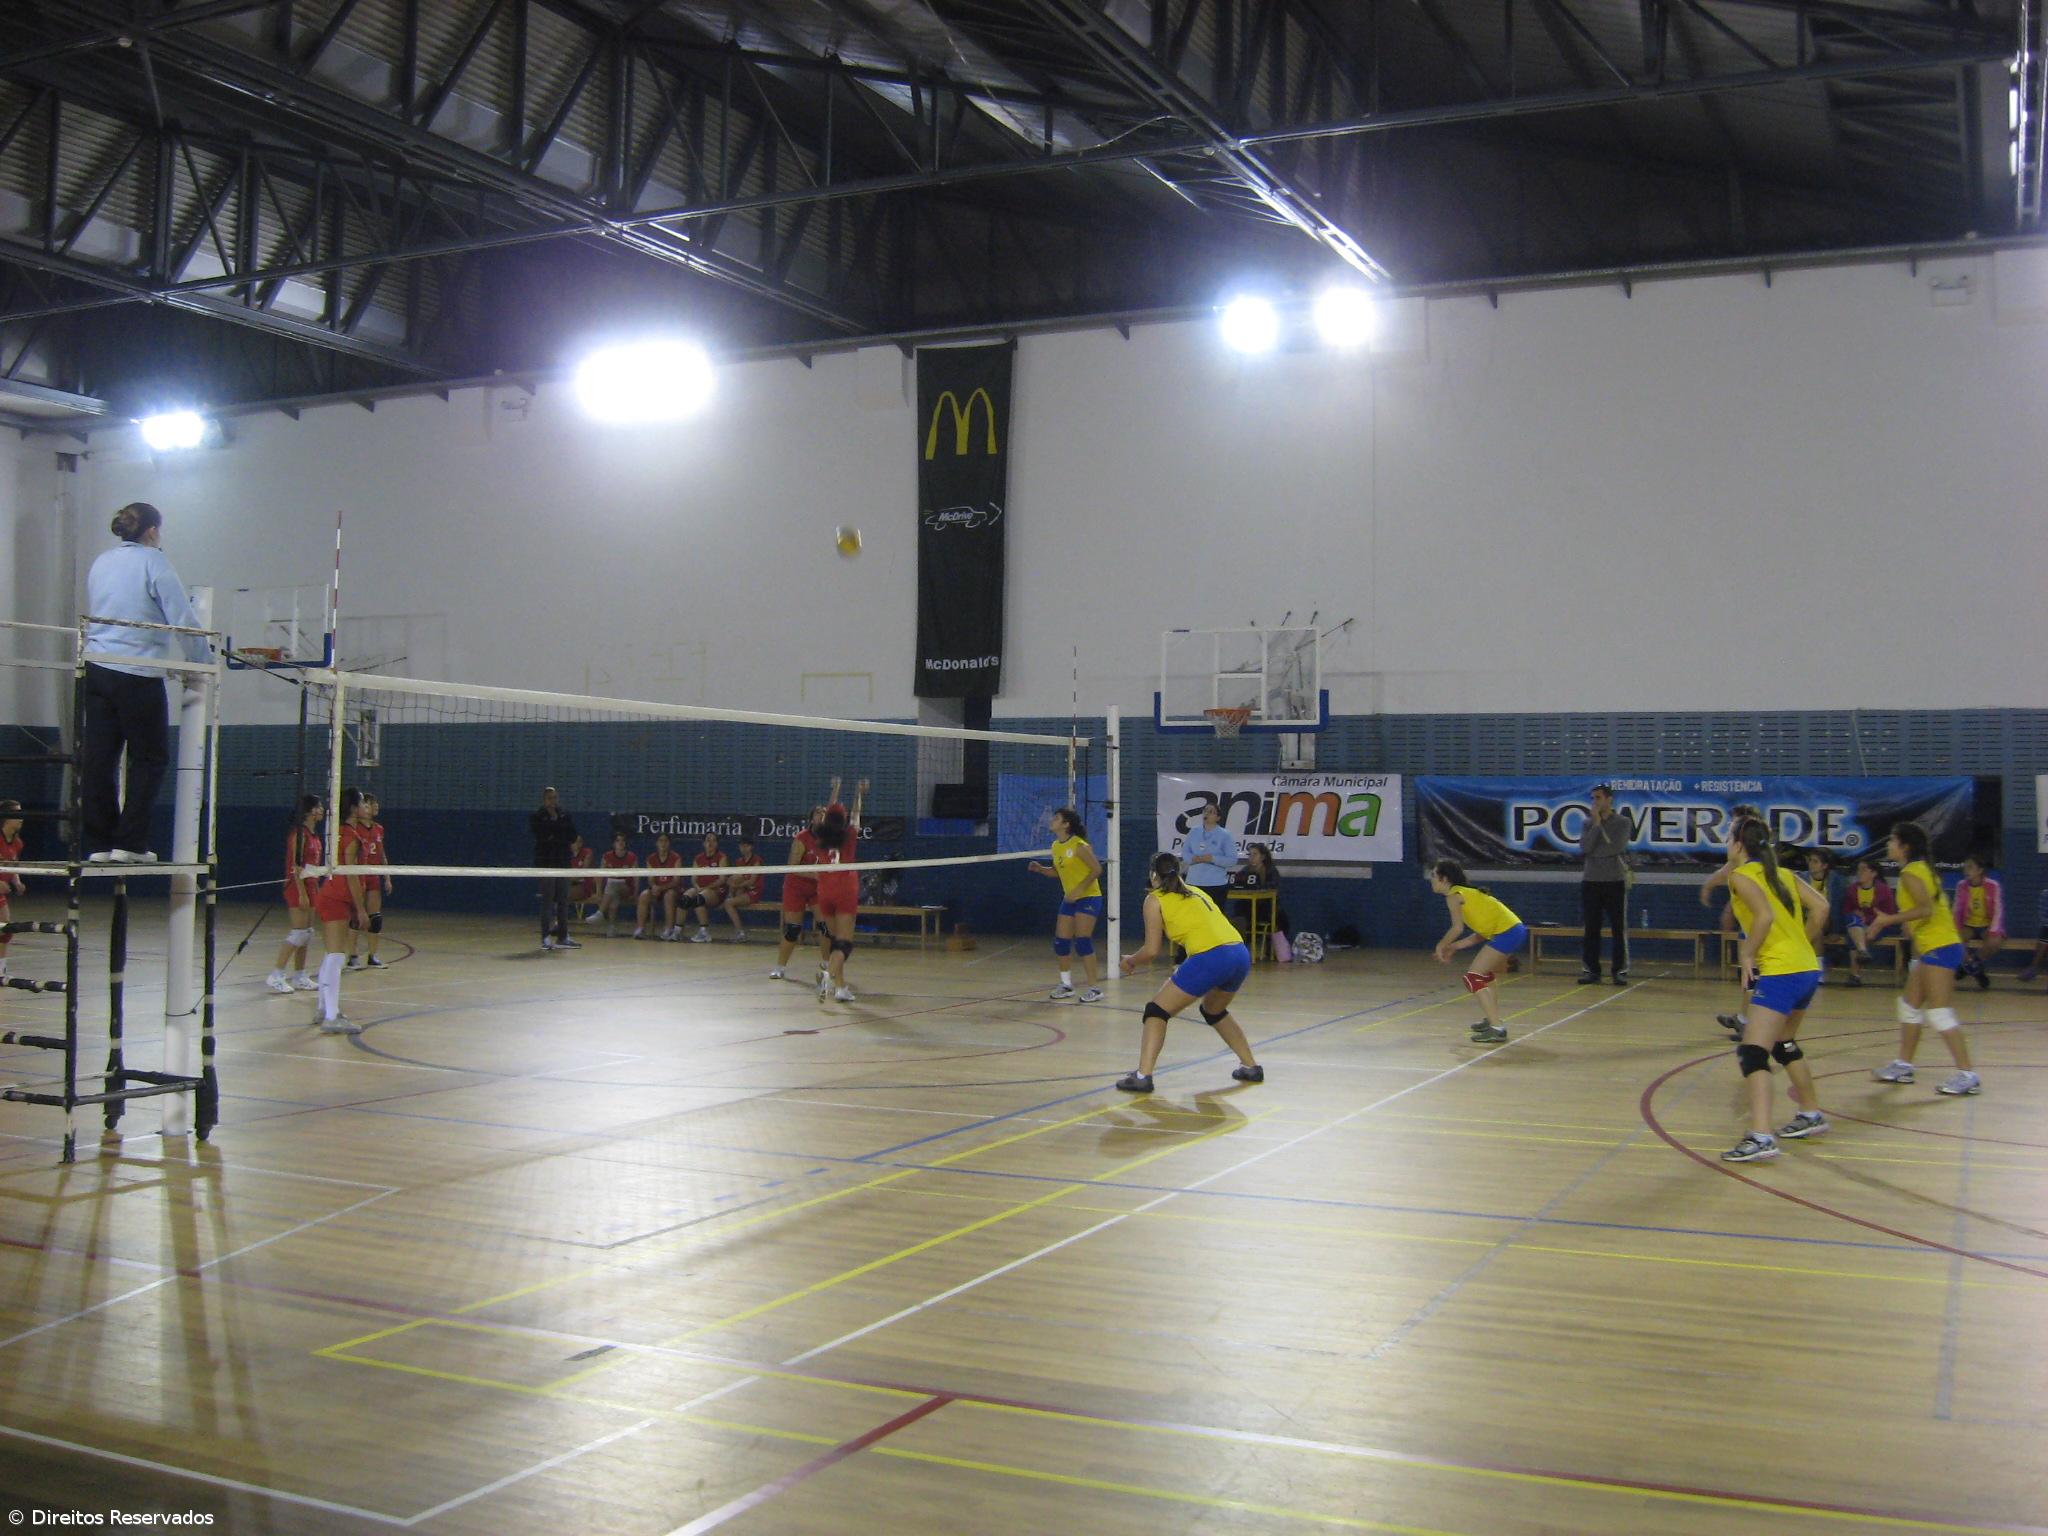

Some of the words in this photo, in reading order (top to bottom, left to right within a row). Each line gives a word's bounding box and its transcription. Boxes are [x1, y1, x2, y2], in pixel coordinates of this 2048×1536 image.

[925, 656, 999, 670] McDonald's
[1272, 775, 1320, 788] Câmara
[1323, 776, 1388, 789] Municipal
[1175, 791, 1382, 837] anima
[637, 815, 742, 836] Perfumaria
